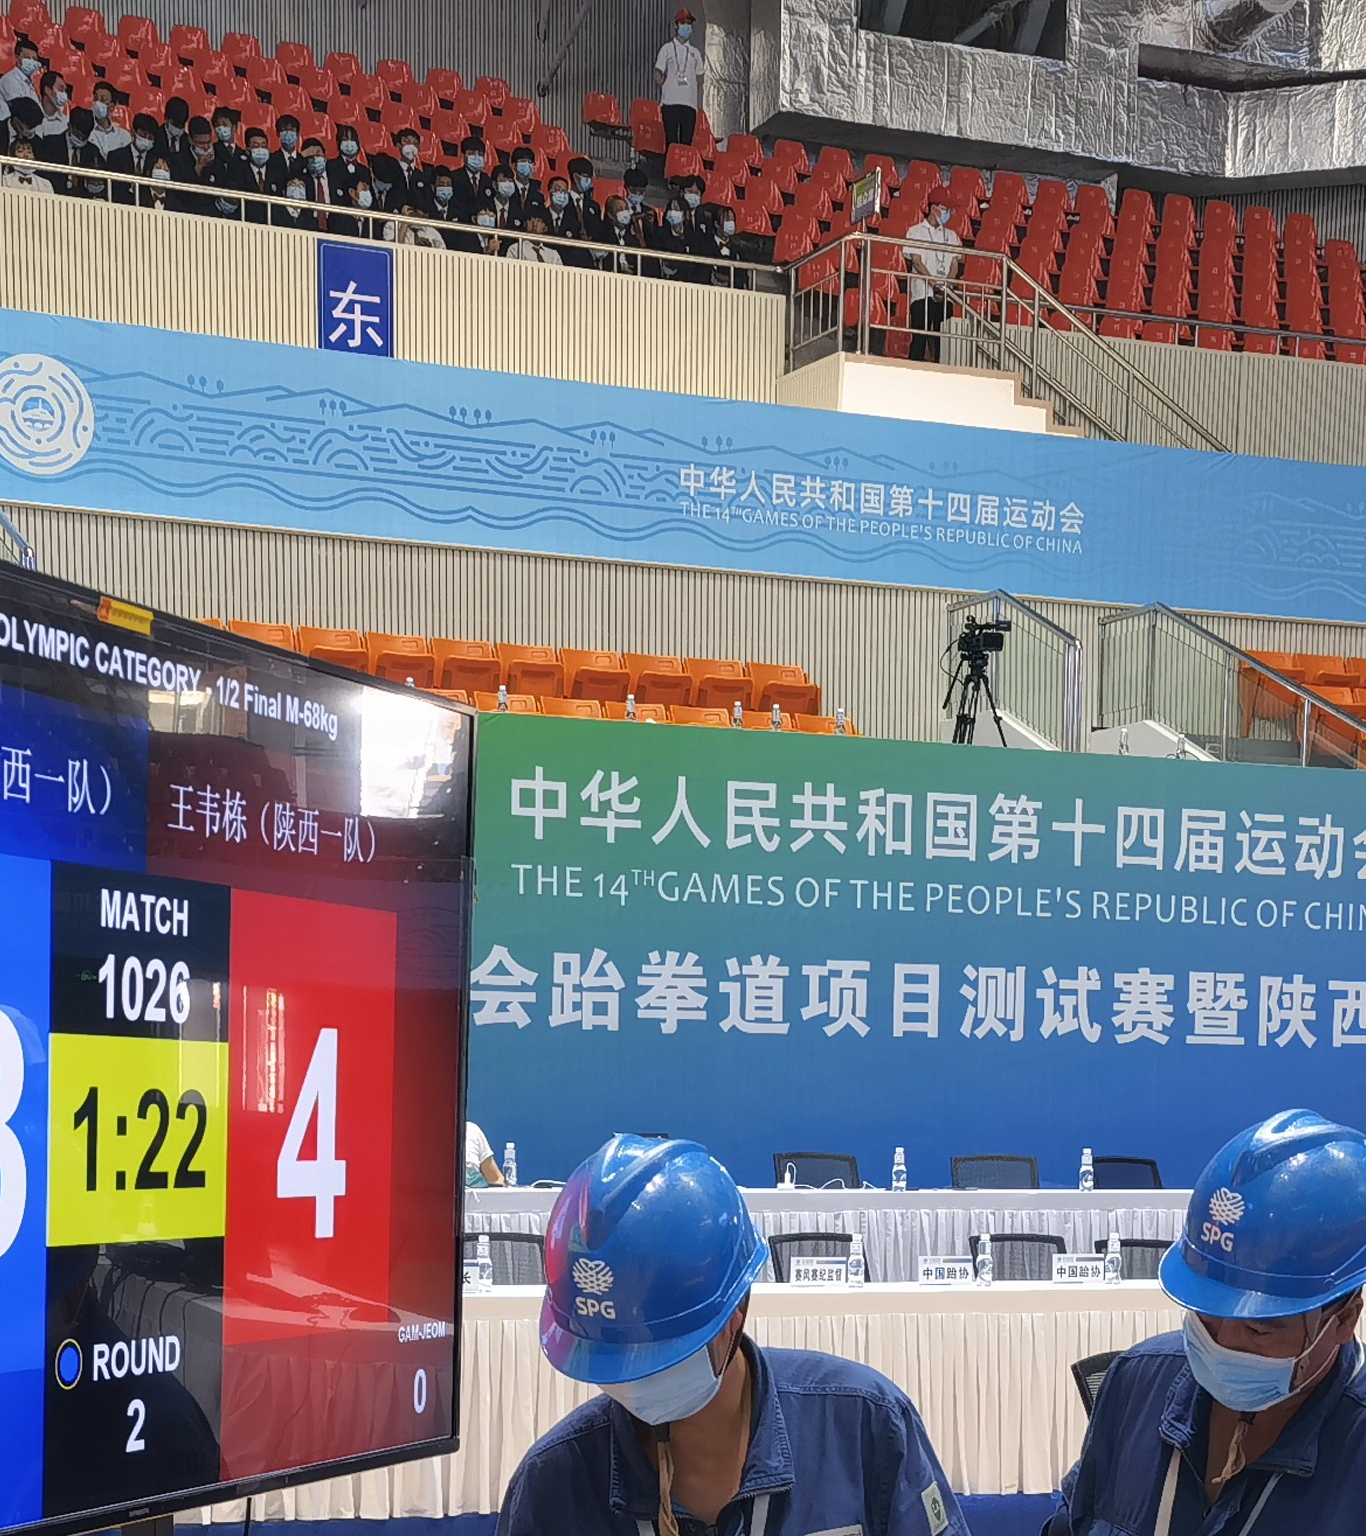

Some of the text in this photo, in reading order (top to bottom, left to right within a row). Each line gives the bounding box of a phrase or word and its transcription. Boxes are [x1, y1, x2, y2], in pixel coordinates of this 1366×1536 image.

[328, 281, 384, 348] 东
[680, 463, 1084, 535] 中华人民共和国第十四届运动会
[680, 502, 712, 519] THE
[802, 514, 824, 529] OF
[826, 516, 856, 533] THE
[860, 520, 932, 541] PEOPLE'S
[937, 527, 1009, 548] REPUBLIC
[1013, 534, 1032, 549] OF
[1036, 537, 1083, 554] CHINA
[95, 642, 202, 693] CATEGORY
[216, 677, 240, 708] 1/2
[244, 680, 281, 720] Final
[286, 695, 338, 740] M-68kg
[101, 889, 189, 937] MATCH
[511, 863, 583, 897] THE
[795, 877, 841, 908] OF
[850, 880, 914, 911] THE
[926, 883, 1081, 919] PEOPLE'S
[1093, 891, 1247, 927] REPUBLIC
[1257, 899, 1296, 928] OF
[98, 953, 191, 1024] 1026
[72, 1086, 208, 1194] 1:22
[277, 1027, 346, 1240] 4
[1200, 1220, 1235, 1253] SPG
[922, 1266, 970, 1280] 中国跆协
[1056, 1265, 1101, 1279] 中国跆协
[399, 1321, 446, 1343] GAM-JEOM
[575, 1297, 616, 1319] SPG
[93, 1335, 181, 1381] ROUND
[413, 1368, 427, 1413] 0
[125, 1399, 146, 1452] 2
